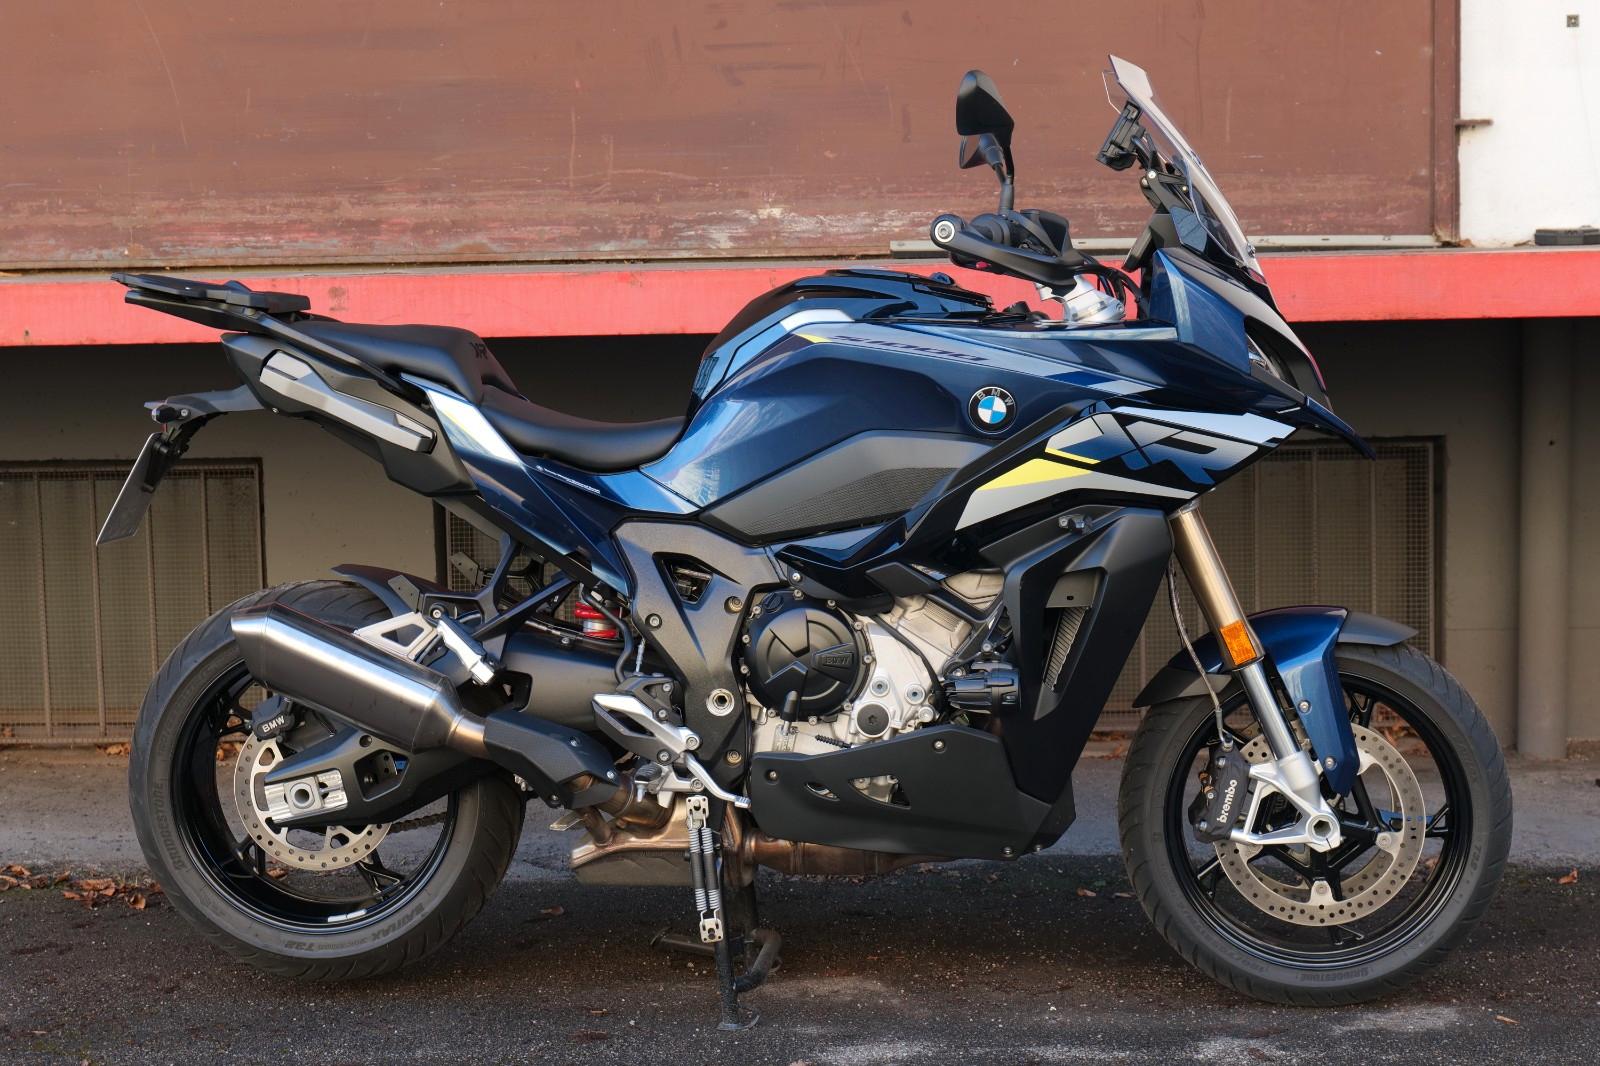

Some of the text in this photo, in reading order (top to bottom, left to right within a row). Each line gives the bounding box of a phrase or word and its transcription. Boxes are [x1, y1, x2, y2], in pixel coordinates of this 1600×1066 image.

[977, 388, 1014, 406] BMW
[825, 655, 849, 665] BMW
[262, 715, 285, 733] BMW
[1216, 779, 1238, 824] brembo
